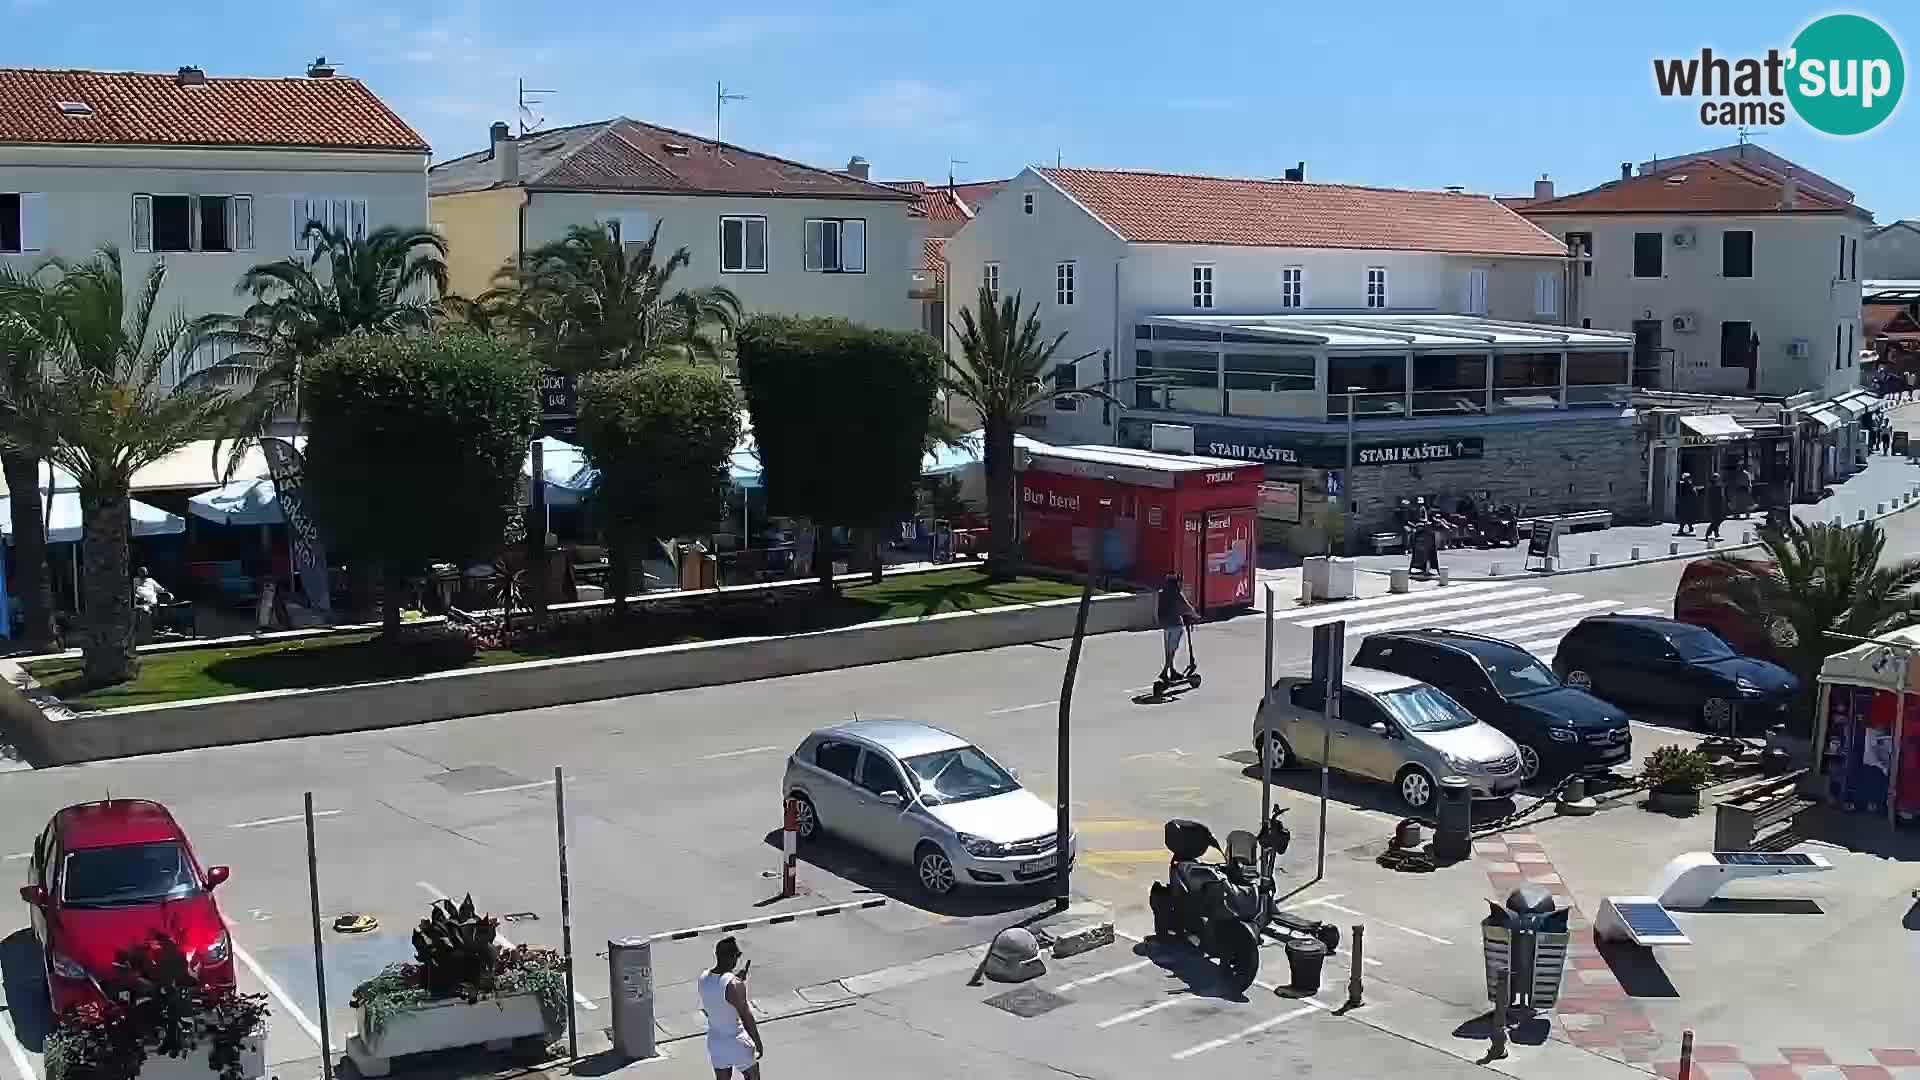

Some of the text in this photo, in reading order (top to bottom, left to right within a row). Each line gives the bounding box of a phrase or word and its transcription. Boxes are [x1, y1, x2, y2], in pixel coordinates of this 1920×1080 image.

[1208, 442, 1298, 463] STARI KAŠTEL
[1359, 442, 1453, 463] STARI KAŠTEL
